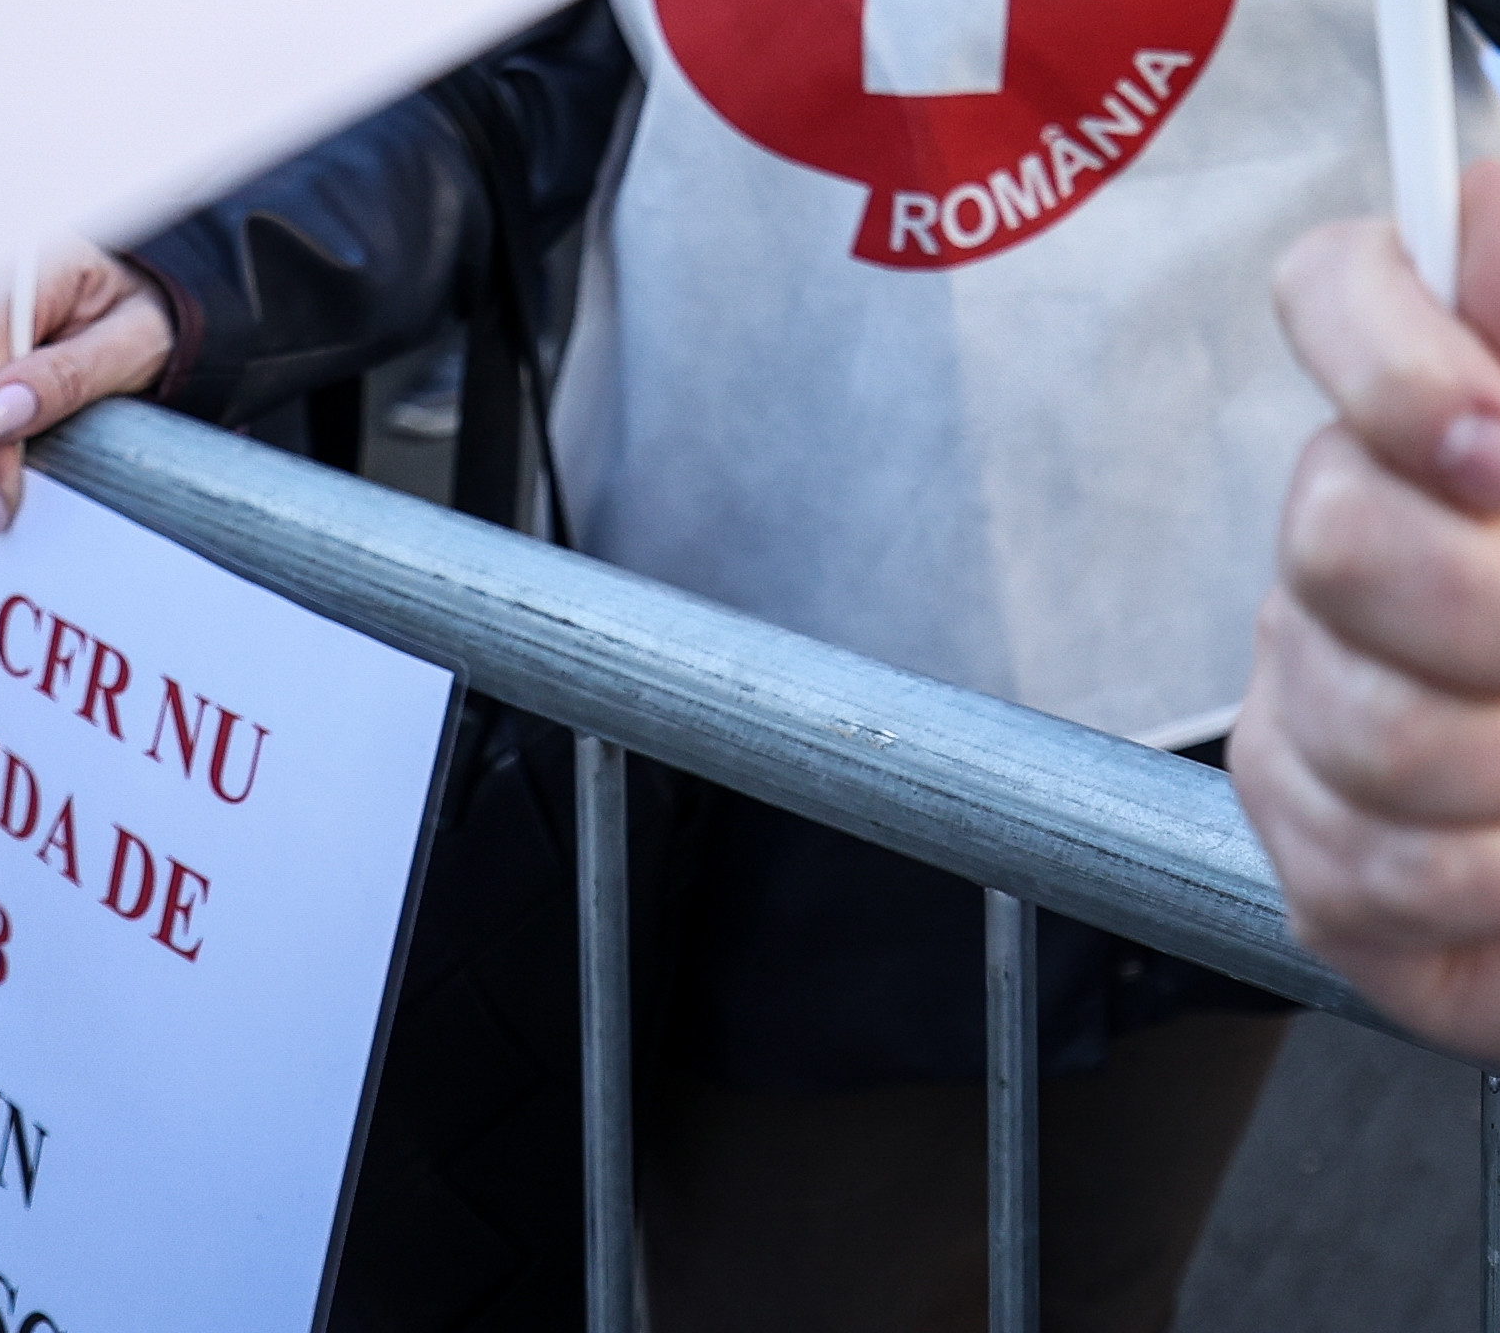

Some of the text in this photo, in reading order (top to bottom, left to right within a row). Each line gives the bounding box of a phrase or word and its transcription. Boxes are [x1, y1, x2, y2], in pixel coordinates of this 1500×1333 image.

[890, 46, 1194, 256] ROMÂNIA
[142, 674, 271, 805] NU
[100, 822, 211, 963] DE
